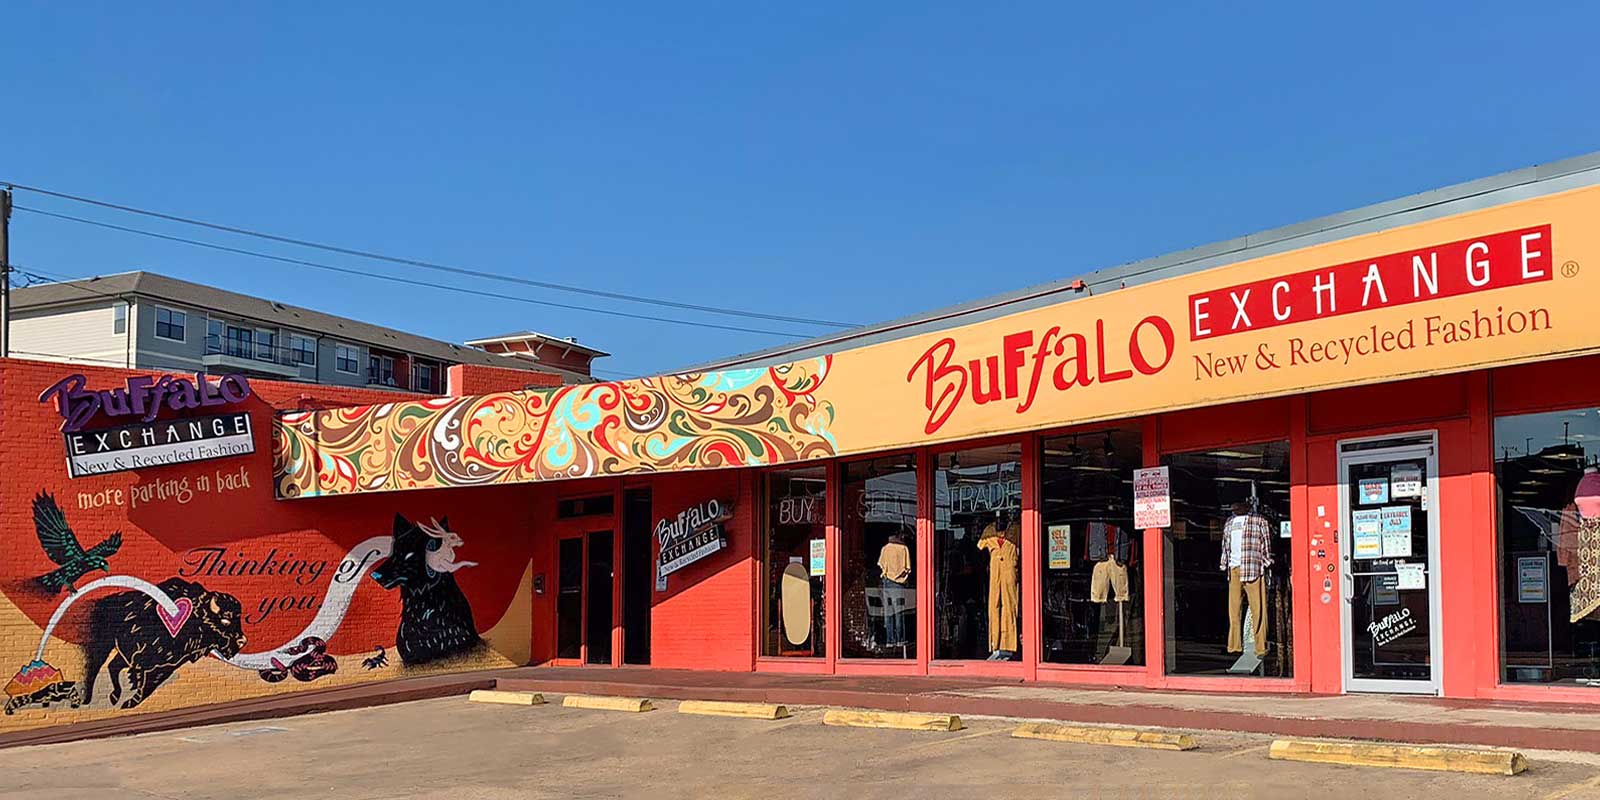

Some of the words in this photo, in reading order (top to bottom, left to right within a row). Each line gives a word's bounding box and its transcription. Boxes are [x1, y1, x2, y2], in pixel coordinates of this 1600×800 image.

[1194, 232, 1545, 337] EXCHANGE
[1193, 352, 1248, 381] New
[1255, 343, 1281, 370] &
[1288, 319, 1416, 366] Recycled
[1424, 306, 1553, 346] Fashion
[72, 415, 247, 455] EXCHANGE
[75, 461, 110, 476] New
[113, 457, 127, 470] &
[131, 447, 195, 467] Recycled
[198, 441, 250, 460] Fashion
[78, 488, 124, 510] more
[131, 477, 193, 508] parking
[196, 474, 210, 492] in
[216, 465, 250, 493] back
[948, 480, 1020, 515] TRADE
[779, 496, 815, 524] BUY
[662, 529, 715, 564] EXCHANGE
[178, 547, 327, 585] Thinking
[334, 549, 381, 584] of
